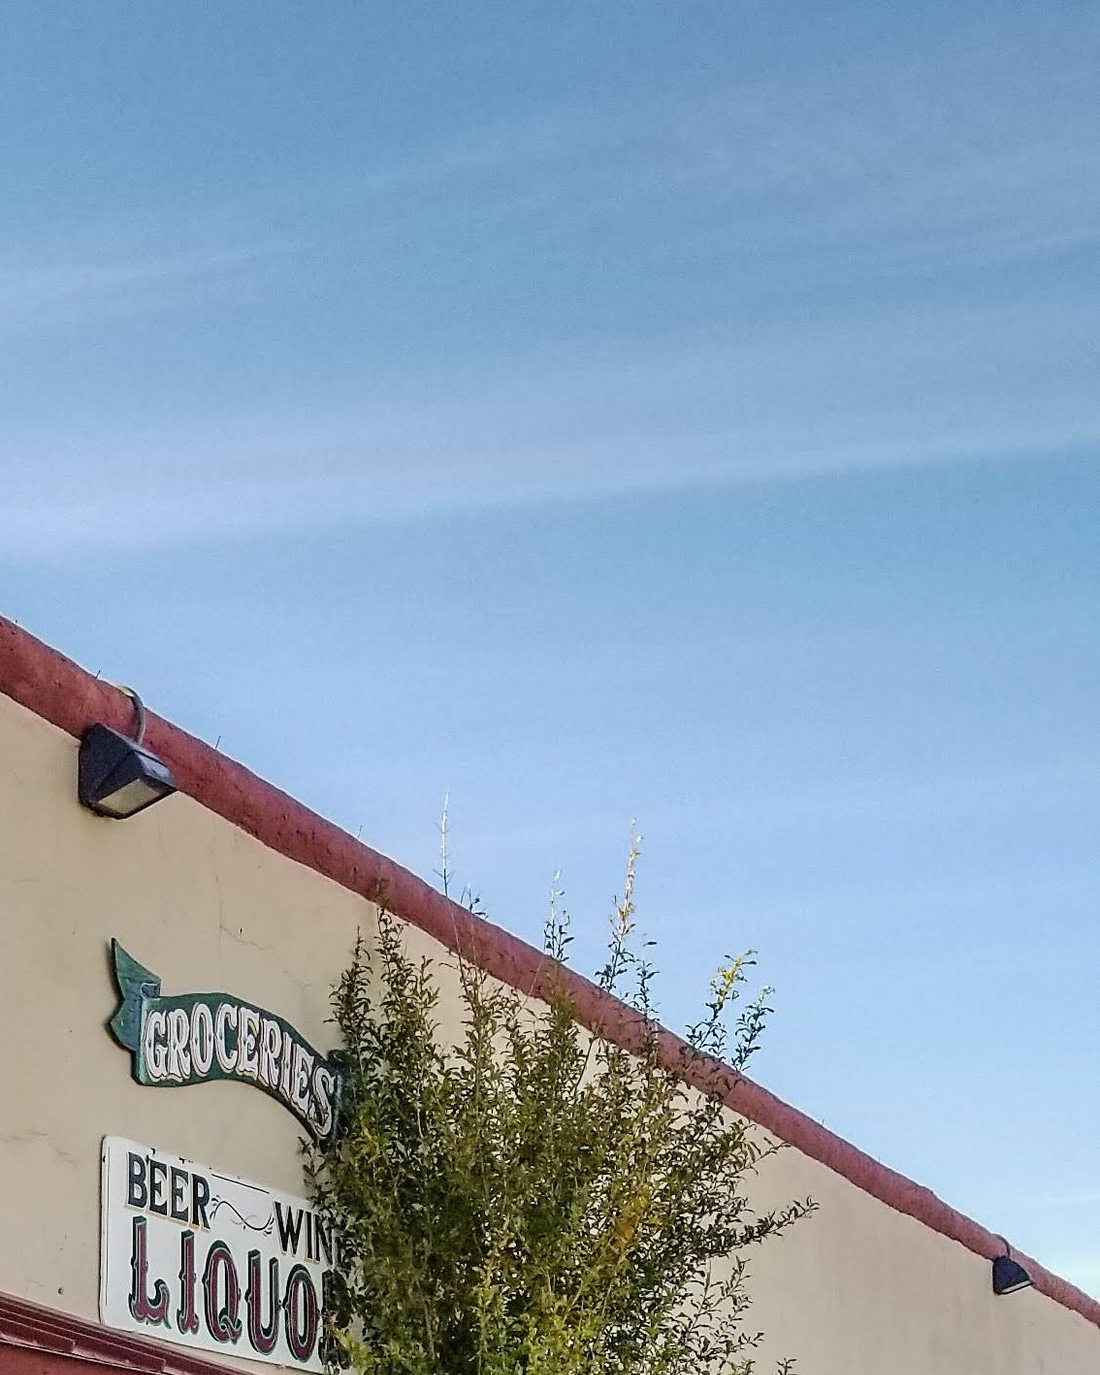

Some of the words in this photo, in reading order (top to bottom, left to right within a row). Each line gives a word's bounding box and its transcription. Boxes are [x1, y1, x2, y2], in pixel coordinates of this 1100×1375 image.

[143, 1001, 338, 1140] GROCERIES
[125, 1151, 211, 1231] BEER
[273, 1201, 346, 1268] WIN
